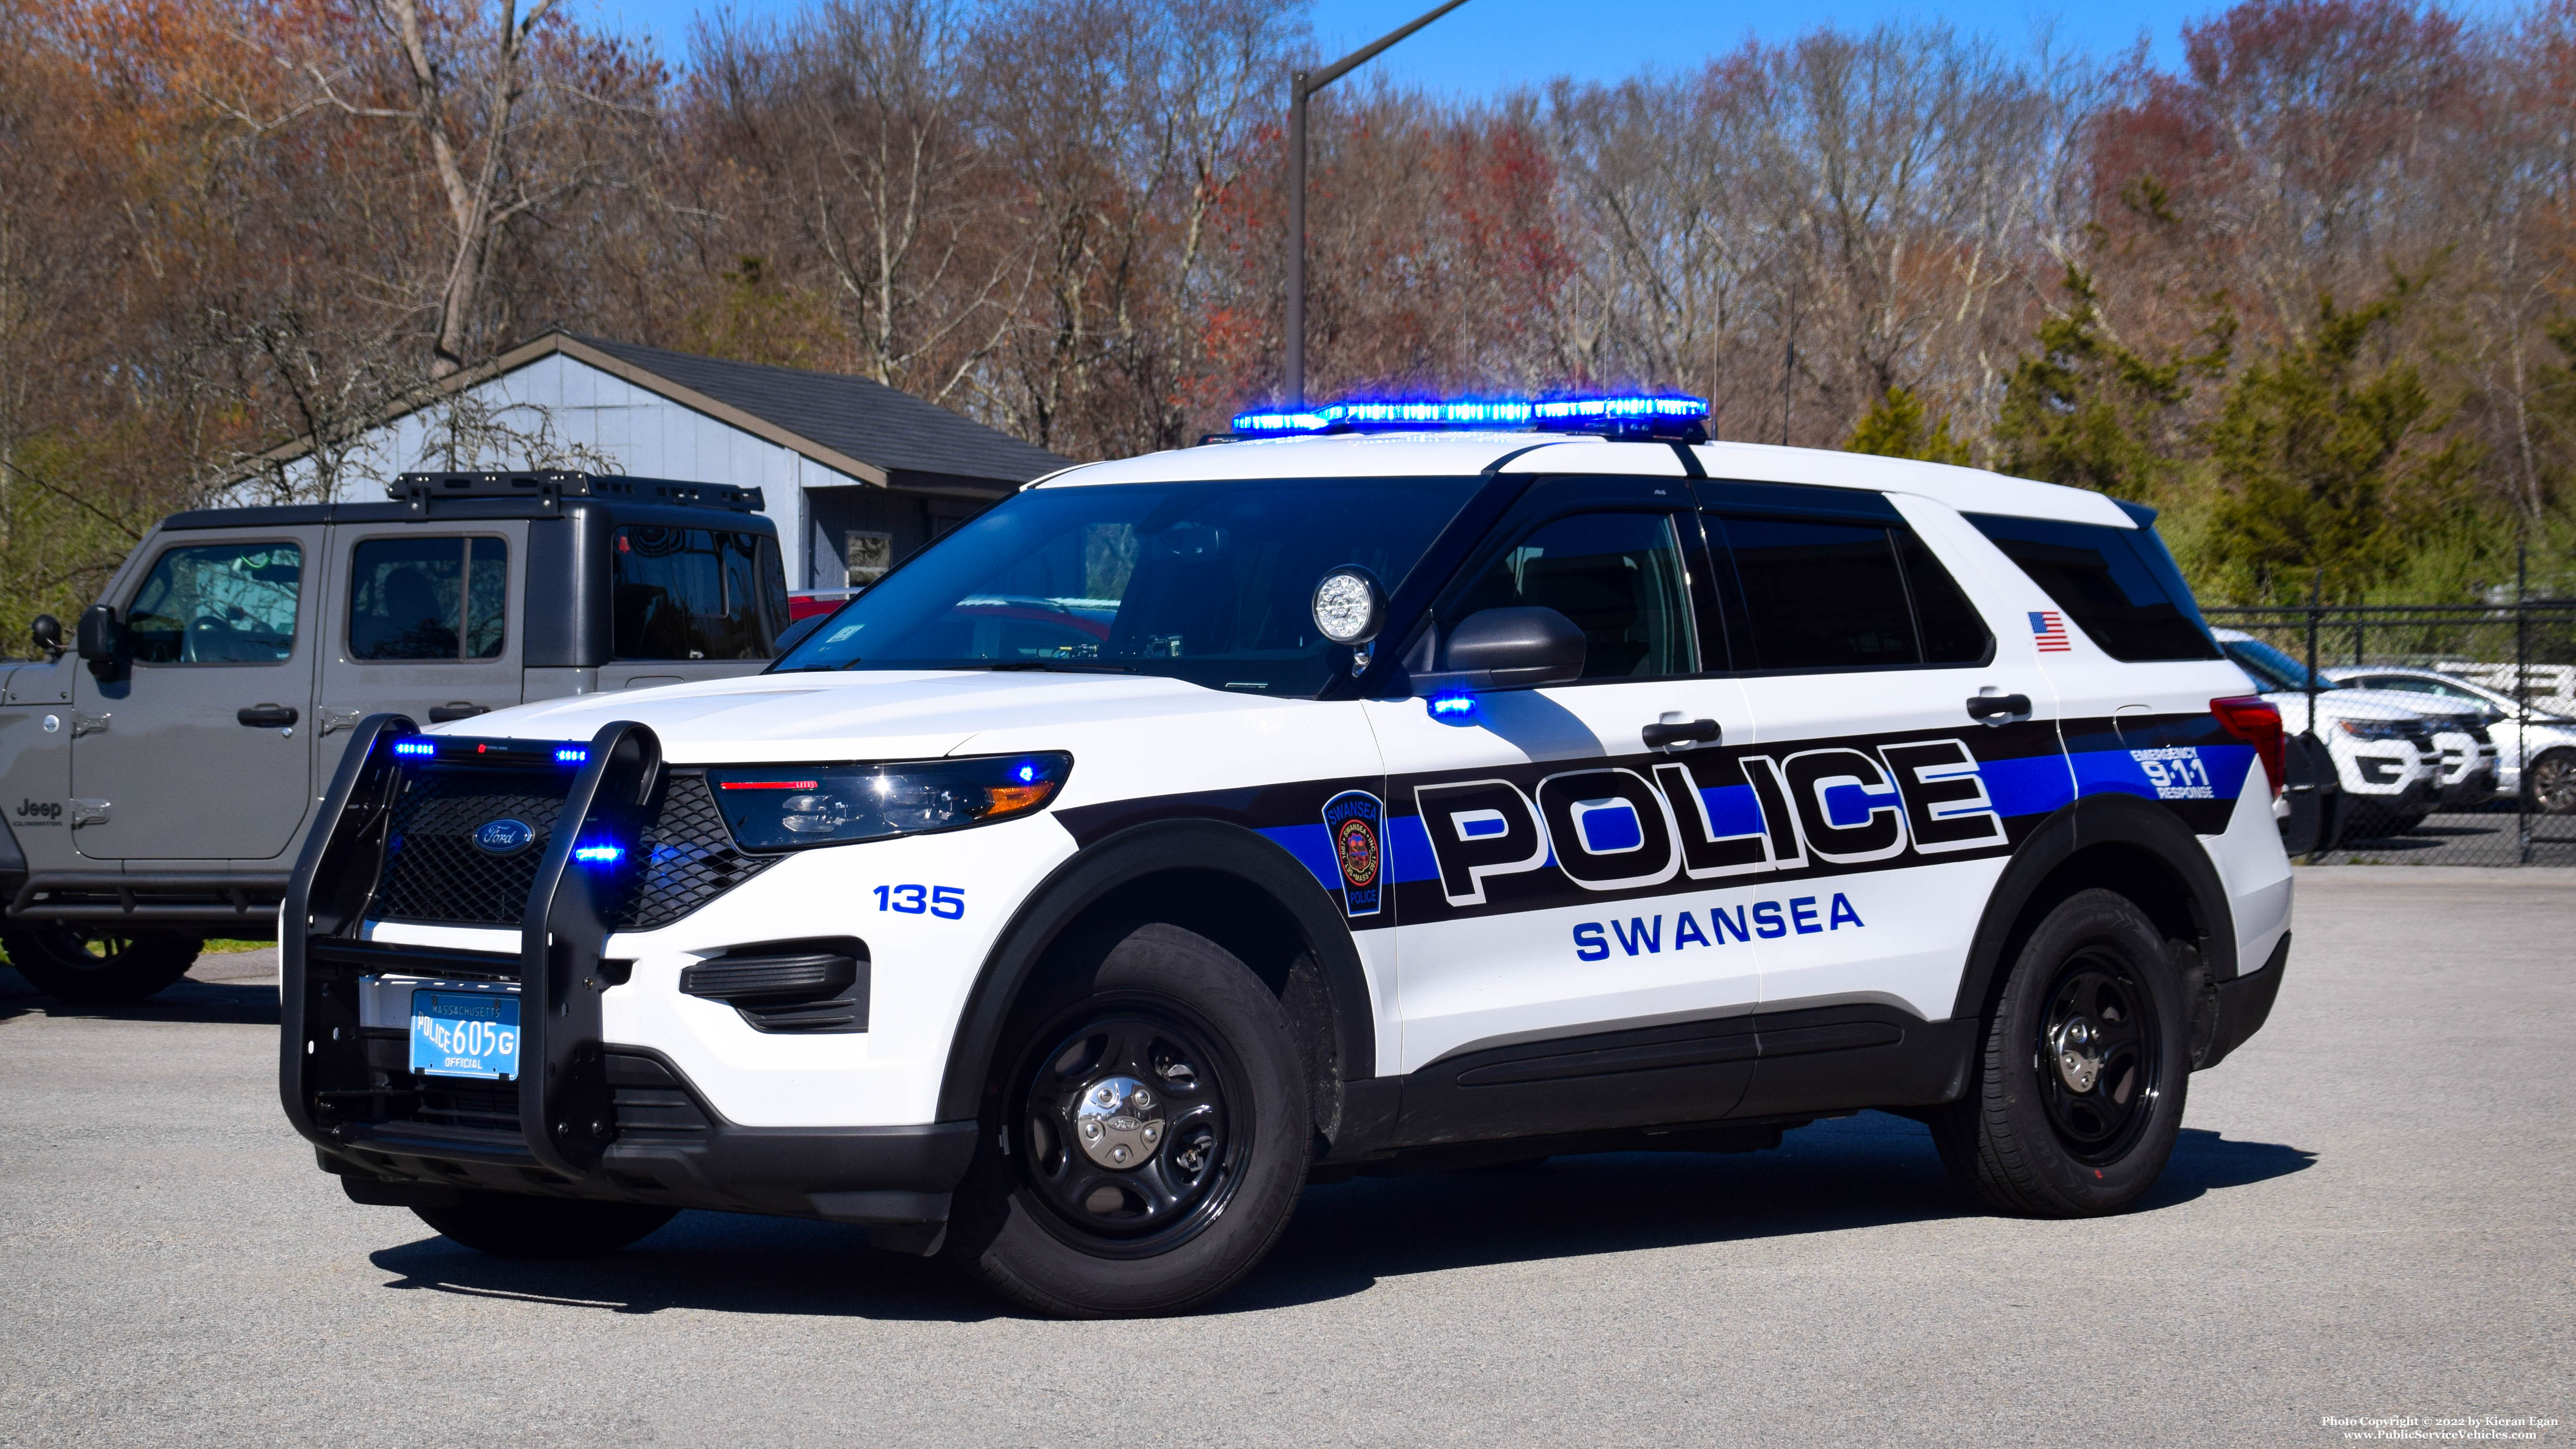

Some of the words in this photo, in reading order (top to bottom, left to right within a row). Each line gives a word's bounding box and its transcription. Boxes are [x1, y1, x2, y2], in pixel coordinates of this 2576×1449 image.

[2130, 747, 2198, 762] EMERGENCY
[2156, 786, 2215, 799] RESPONSE
[17, 798, 62, 819] Jeep
[1327, 801, 1377, 826] SWANSEA
[1343, 823, 1366, 838] SWANSEA
[1414, 738, 2010, 907] POLICE
[484, 825, 517, 843] Ford
[1355, 872, 1369, 882] MASS
[873, 884, 965, 920] 135
[1350, 889, 1377, 904] POLICE
[1572, 892, 1865, 962] SWANSEA
[432, 1005, 501, 1018] MASSACHUSETTS
[418, 1010, 451, 1054] POLICE
[445, 1057, 483, 1070] OFFICIAL
